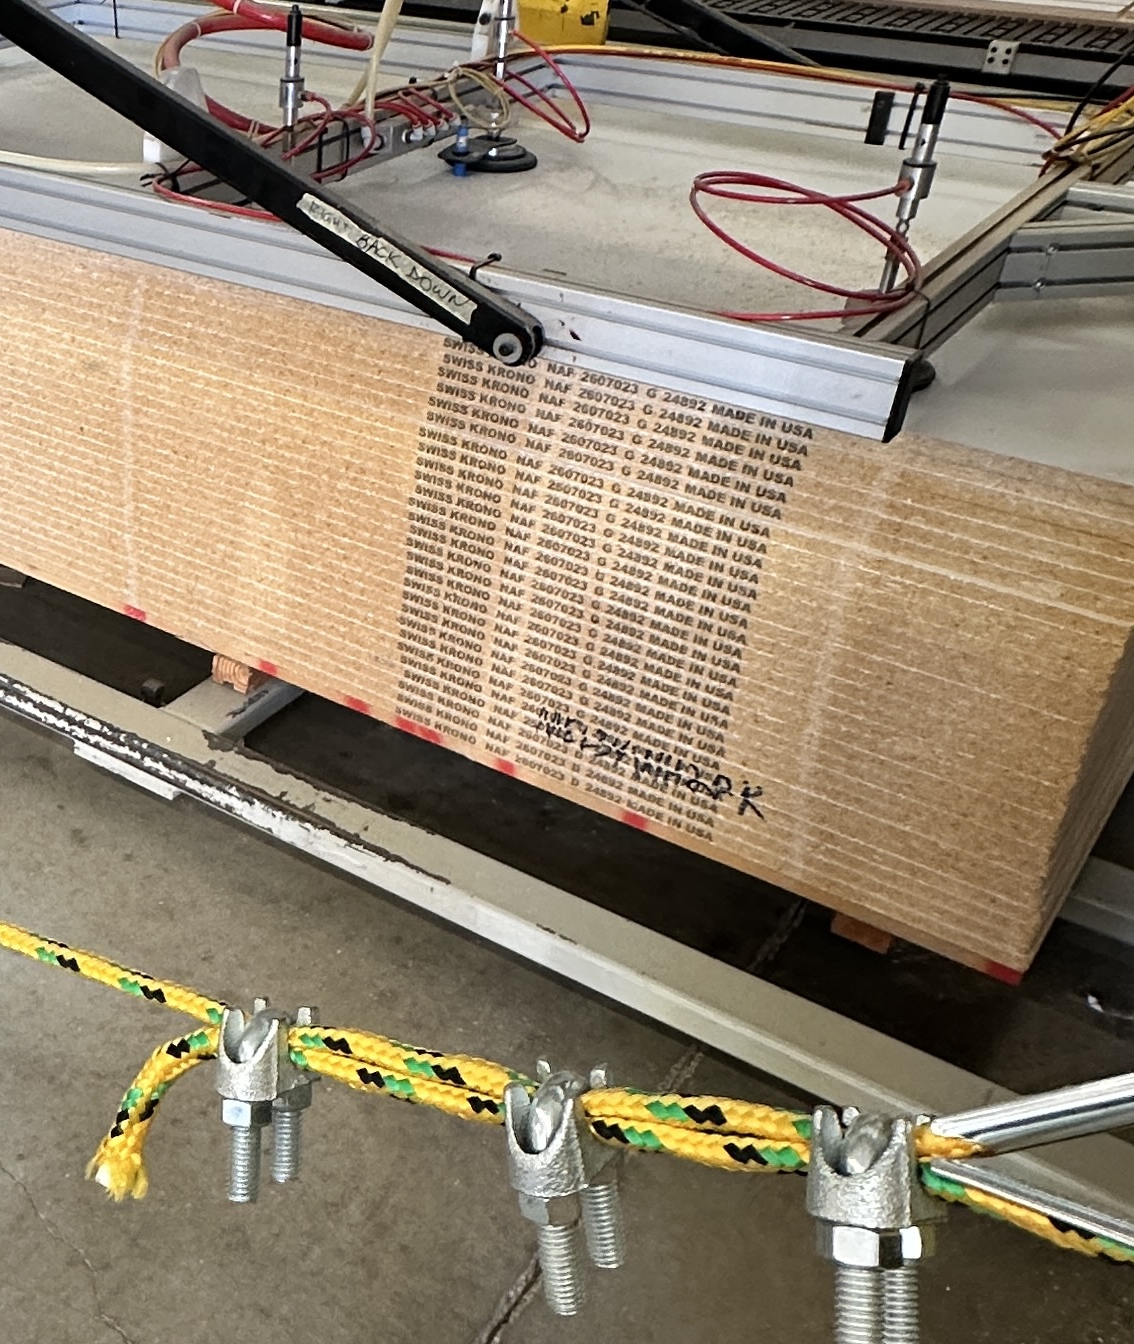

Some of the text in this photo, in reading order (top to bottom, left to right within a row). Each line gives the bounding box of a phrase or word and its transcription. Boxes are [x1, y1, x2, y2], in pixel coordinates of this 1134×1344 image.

[355, 233, 399, 269] BACK
[405, 265, 470, 307] DOWN
[427, 395, 468, 416] SWISS
[471, 407, 519, 430] KRONO
[527, 422, 555, 439] NAF
[687, 466, 730, 488] MADE
[733, 480, 751, 494] IN
[754, 486, 788, 505] USA
[436, 382, 476, 402] SWISS
[479, 393, 526, 415] KRONO
[535, 408, 561, 425] NAF
[694, 451, 737, 472] MADE
[740, 463, 758, 478] IN
[761, 469, 795, 488] USA
[437, 366, 477, 386] SWISS
[481, 377, 529, 399] KRONO
[537, 392, 565, 409] NAF
[700, 435, 744, 457] MADE
[747, 447, 765, 462] IN
[768, 453, 803, 472] USA
[443, 353, 483, 372] SWISS
[487, 364, 536, 386] KRONO
[543, 378, 571, 395] NAF
[706, 420, 751, 442] MADE
[754, 433, 772, 447] IN
[775, 438, 810, 457] USA
[544, 362, 573, 379] NAF
[710, 404, 756, 425] MADE
[758, 416, 777, 431] IN
[779, 421, 814, 440] USA
[415, 455, 454, 476] SWISS
[457, 468, 504, 490] KRONO
[511, 483, 538, 500] NAF
[666, 531, 708, 553] MADE
[710, 545, 728, 559] IN
[731, 551, 763, 570] USA
[417, 441, 456, 461] SWISS
[459, 453, 506, 476] KRONO
[514, 469, 541, 486] NAF
[670, 516, 712, 538] MADE
[715, 529, 733, 544] IN
[735, 536, 768, 555] USA
[418, 426, 457, 447] SWISS
[460, 438, 507, 461] KRONO
[515, 454, 542, 470] NAF
[671, 500, 715, 522] MADE
[717, 514, 735, 528] IN
[738, 519, 772, 539] USA
[426, 411, 465, 431] SWISS
[469, 422, 516, 444] KRONO
[524, 438, 551, 454] NAF
[683, 482, 726, 504] MADE
[728, 496, 746, 510] IN
[749, 501, 782, 520] USA
